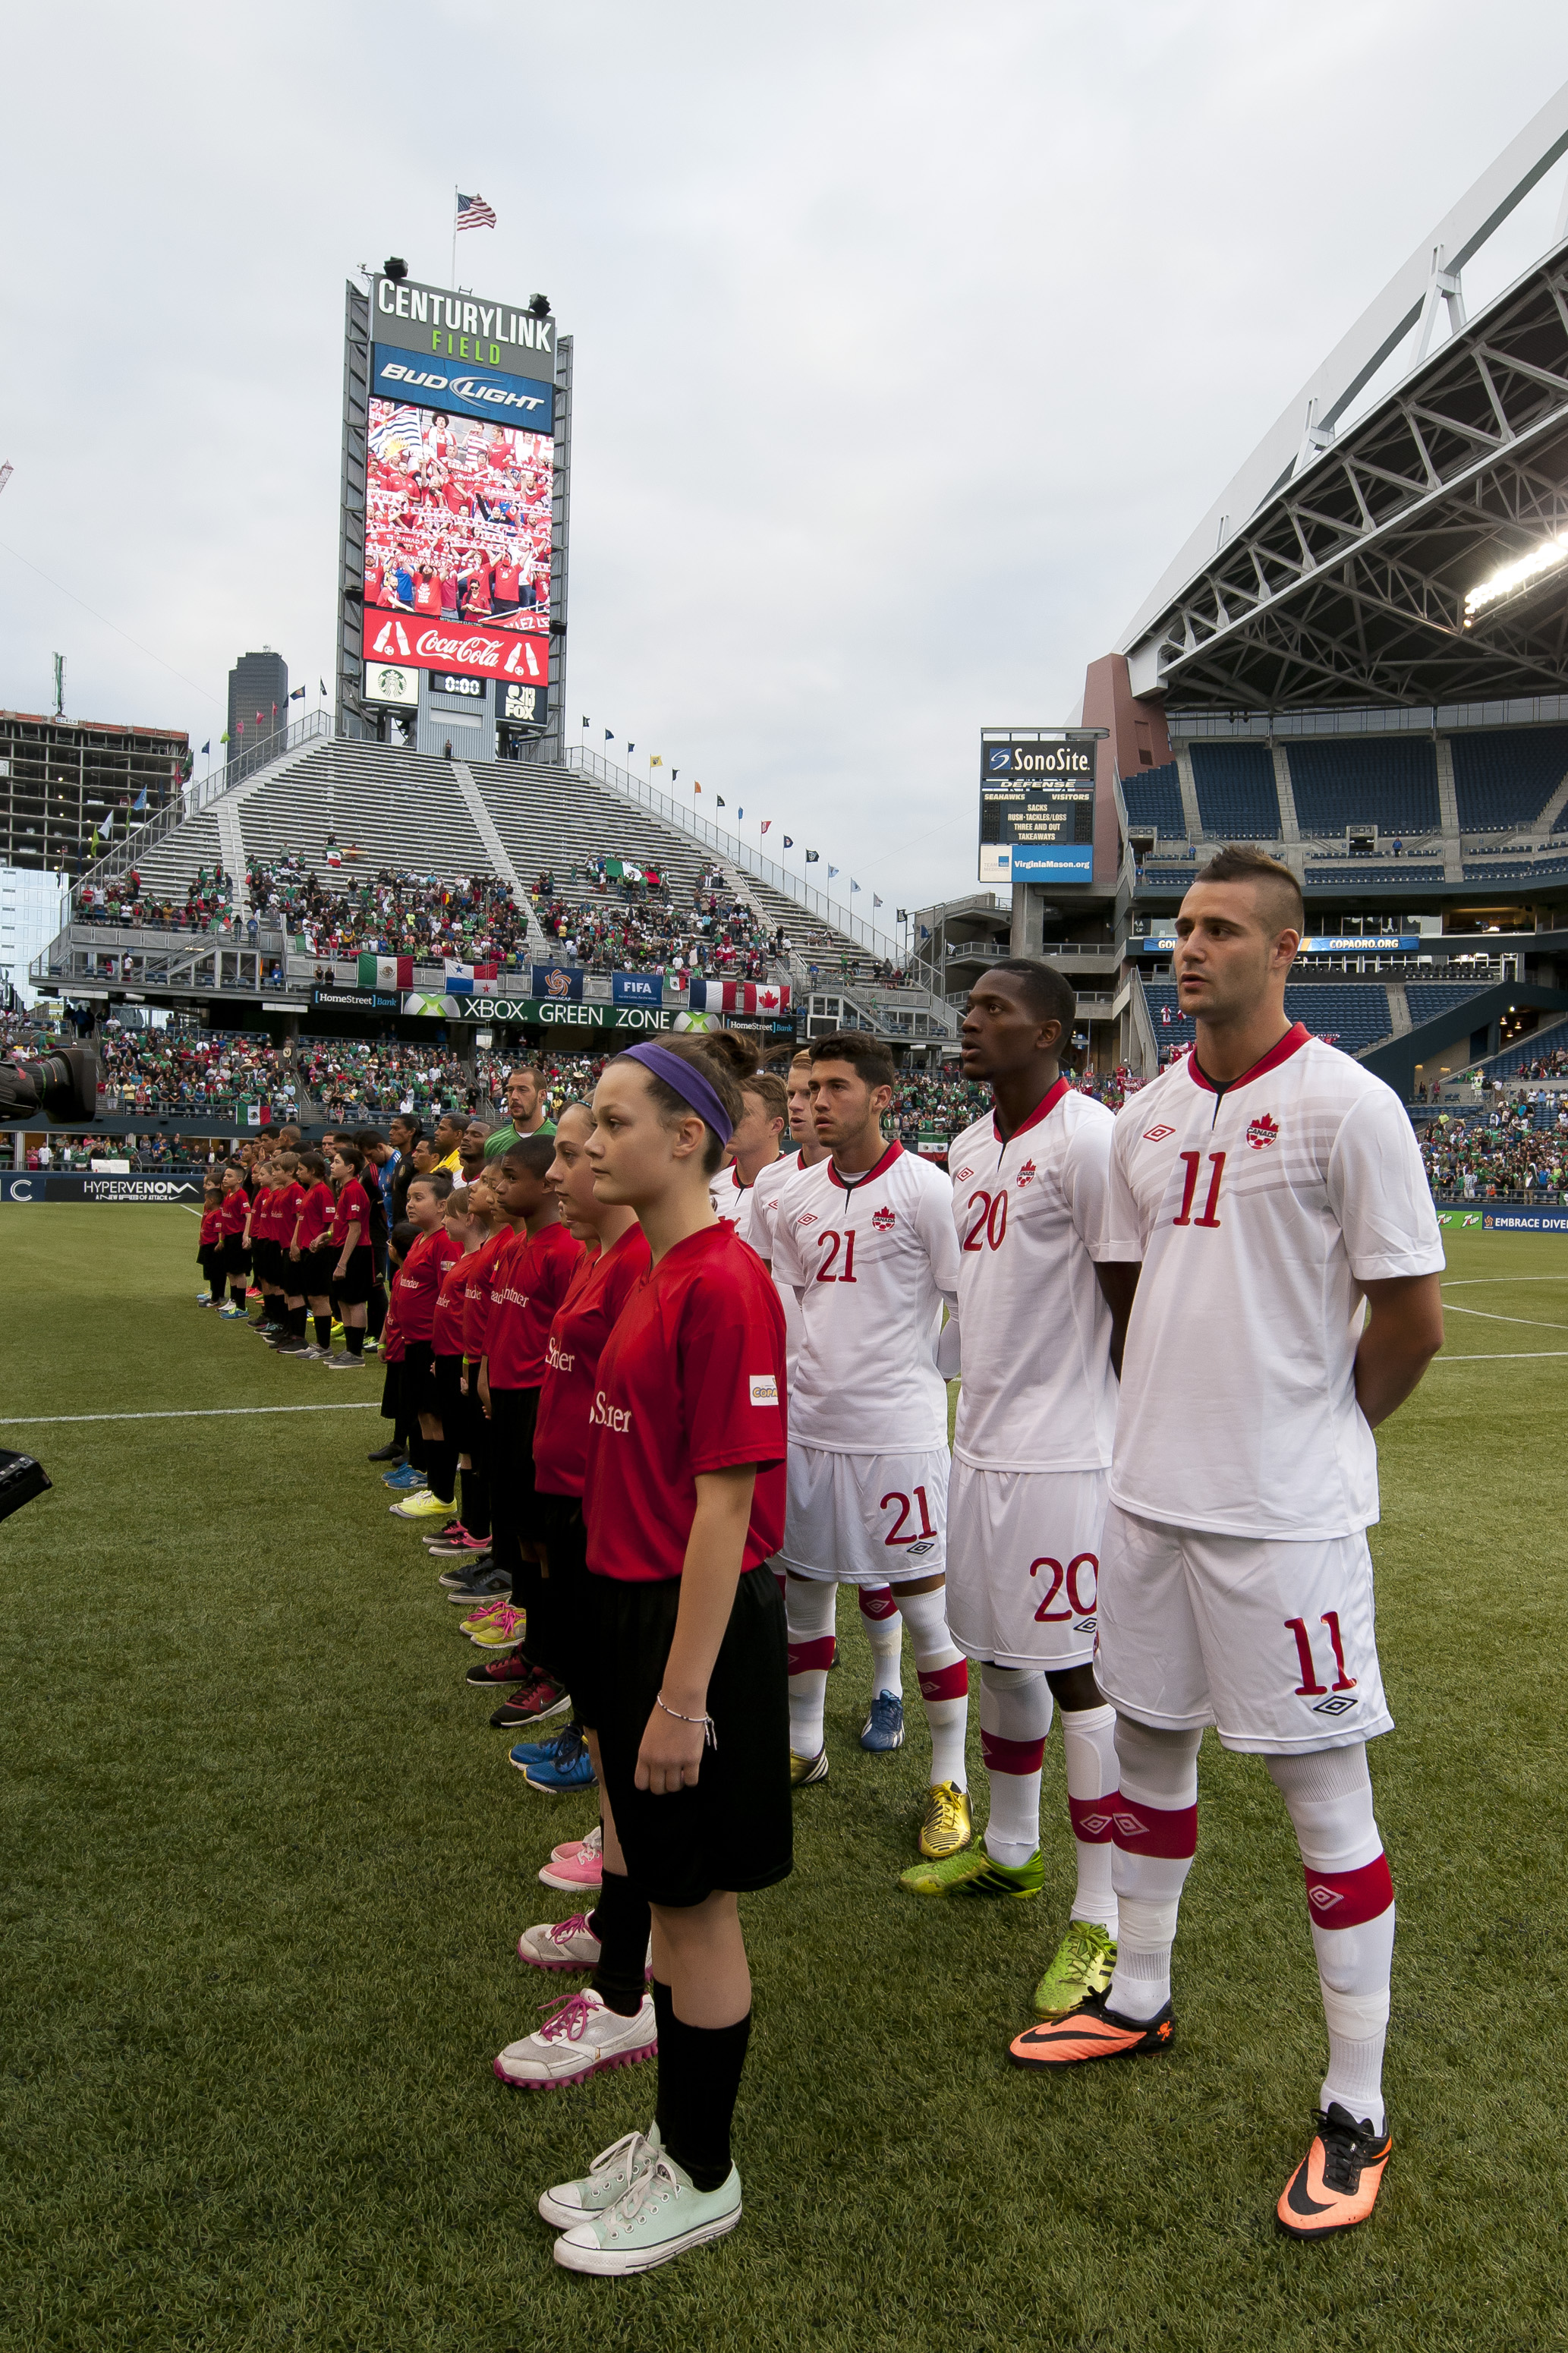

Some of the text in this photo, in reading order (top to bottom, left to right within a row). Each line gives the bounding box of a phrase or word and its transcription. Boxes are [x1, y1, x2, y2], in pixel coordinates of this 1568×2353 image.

[379, 279, 552, 353] CENTURYLINK
[432, 330, 500, 365] FIELD
[380, 363, 545, 411] BUD LIGHT
[417, 629, 504, 667] Coca-Cola
[445, 676, 480, 696] 0:00
[505, 704, 535, 721] FOX
[1014, 748, 1090, 771] SonoSite
[1014, 860, 1091, 869] VirginiaMason.org
[1330, 939, 1399, 949] COPAORO.ORG
[624, 981, 652, 994] FIFA
[376, 997, 397, 1006] Bank
[464, 997, 671, 1030] XBOX GREEN ZONE
[776, 1024, 792, 1032] Bank
[1246, 1126, 1277, 1139] CANADA
[83, 1181, 200, 1194] HYPERVENOM
[1173, 1151, 1226, 1228] 11
[872, 1216, 896, 1224] CANADA
[963, 1189, 1009, 1252] 20
[1495, 1217, 1540, 1228] EMBRACE
[816, 1229, 858, 1283] 21
[880, 1485, 937, 1546] 21
[1029, 1552, 1099, 1623] 20
[1283, 1611, 1358, 1696] 11
